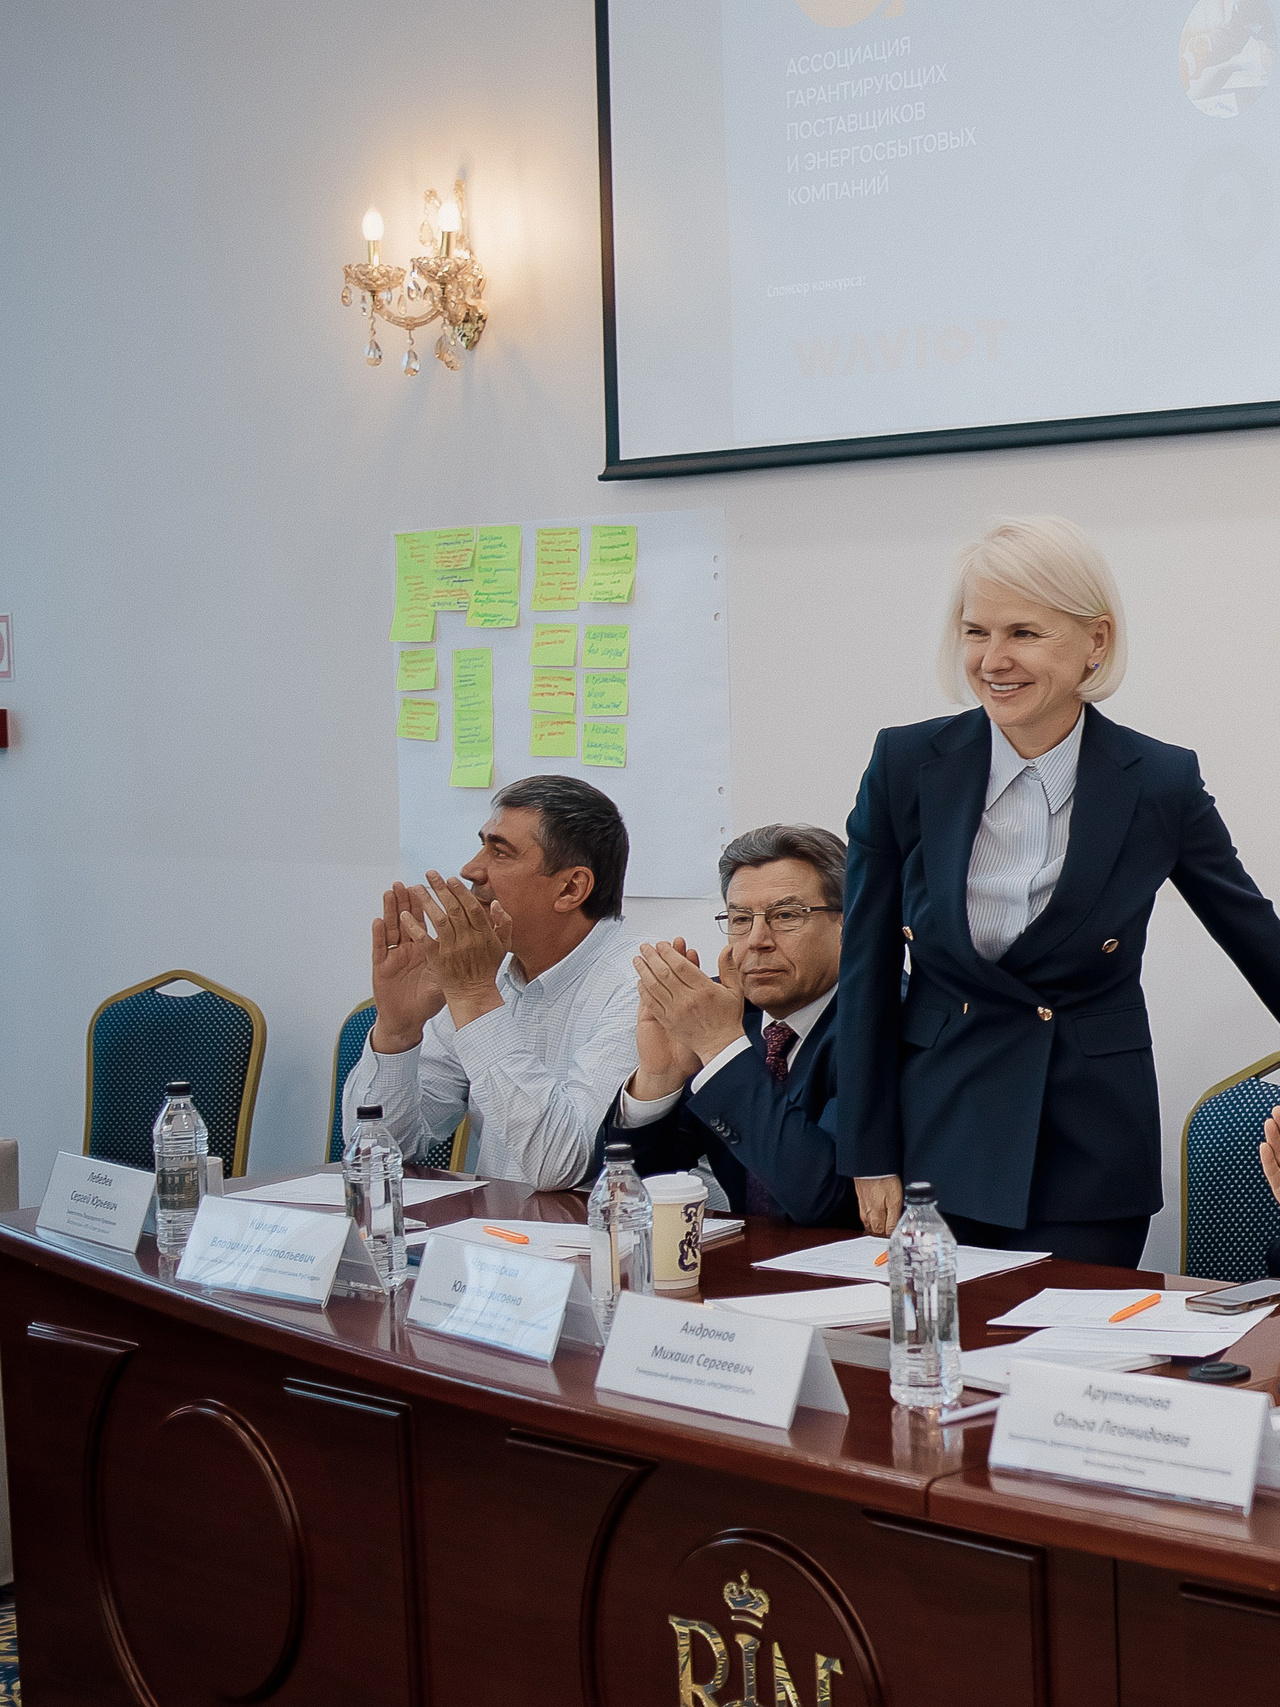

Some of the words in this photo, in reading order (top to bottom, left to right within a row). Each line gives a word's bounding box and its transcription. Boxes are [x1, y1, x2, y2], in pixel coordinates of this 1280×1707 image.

[785, 36, 912, 77] АССОЦИАЦИЯ
[785, 62, 949, 108] ГАРАНТИРУЮЩИХ
[786, 101, 927, 141] ПОСТАВЩИКОВ
[787, 155, 800, 173] И
[804, 126, 979, 172] ЭНЕРГОСБЫТОВЫХ
[786, 170, 890, 206] КОМПАНИЙ
[766, 281, 810, 298] Спонсор
[811, 275, 867, 292] конкурса:
[791, 317, 1008, 379] WAVIOT
[87, 1171, 114, 1187] Лебедев
[70, 1190, 92, 1205] Сергей
[90, 1195, 118, 1211] Юрьевич
[250, 1218, 289, 1235] Кимерин
[210, 1236, 253, 1256] Владимир
[254, 1243, 316, 1264] Анатольевич
[680, 1321, 736, 1342] Андронов
[650, 1345, 694, 1365] Михаил
[696, 1353, 755, 1376] Сергеевич
[1083, 1384, 1173, 1411] Арутюнова
[1053, 1411, 1096, 1432] Ольга
[1098, 1420, 1191, 1447] Леонидовна
